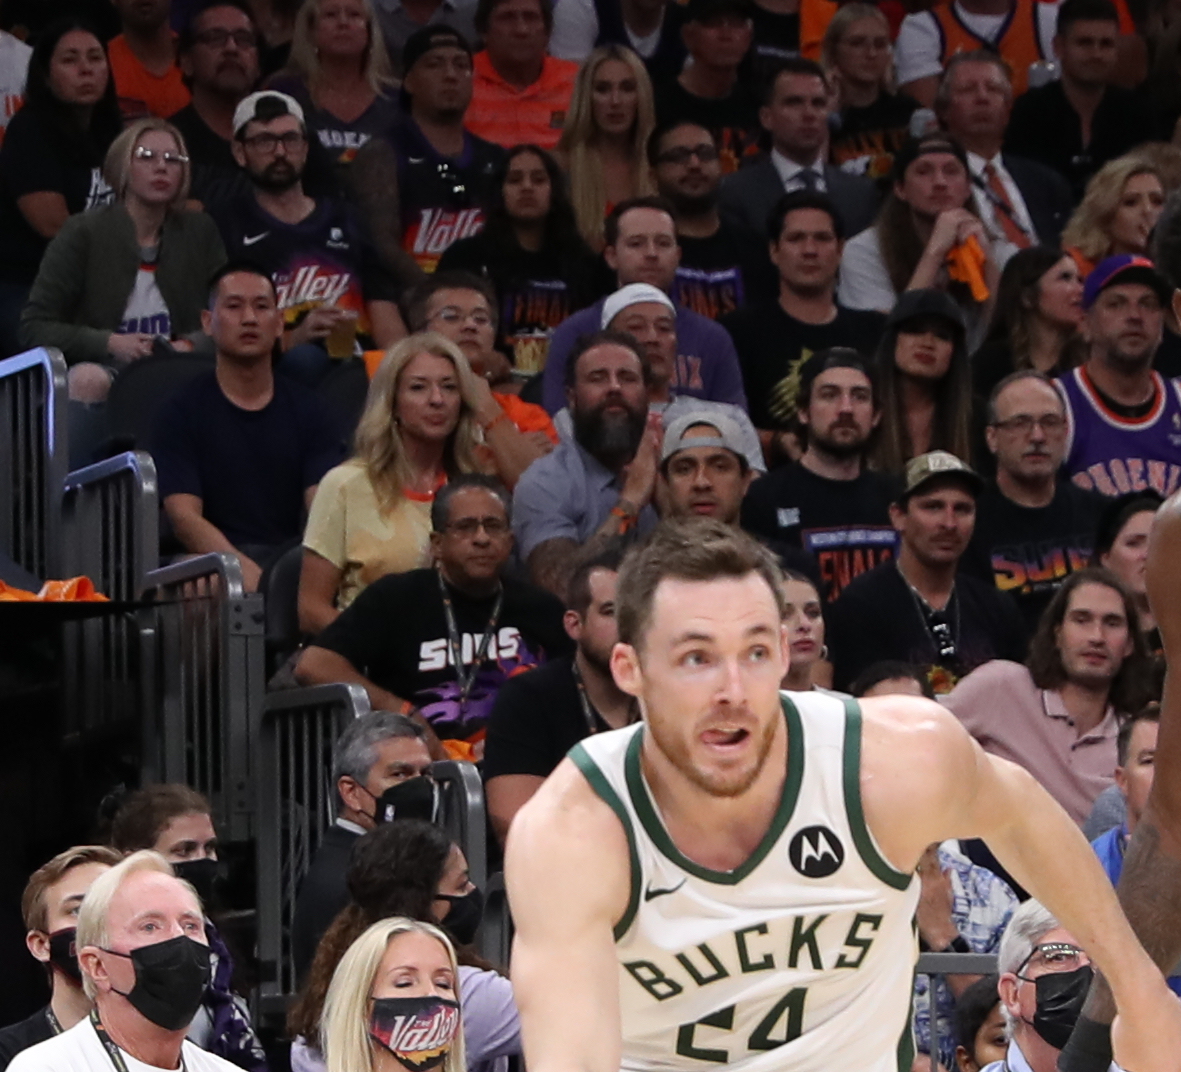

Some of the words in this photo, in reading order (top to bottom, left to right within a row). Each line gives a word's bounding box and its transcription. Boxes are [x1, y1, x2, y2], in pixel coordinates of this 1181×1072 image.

[418, 627, 521, 671] SUNS
[623, 913, 883, 1001] BUCKS
[676, 987, 808, 1063] 24
